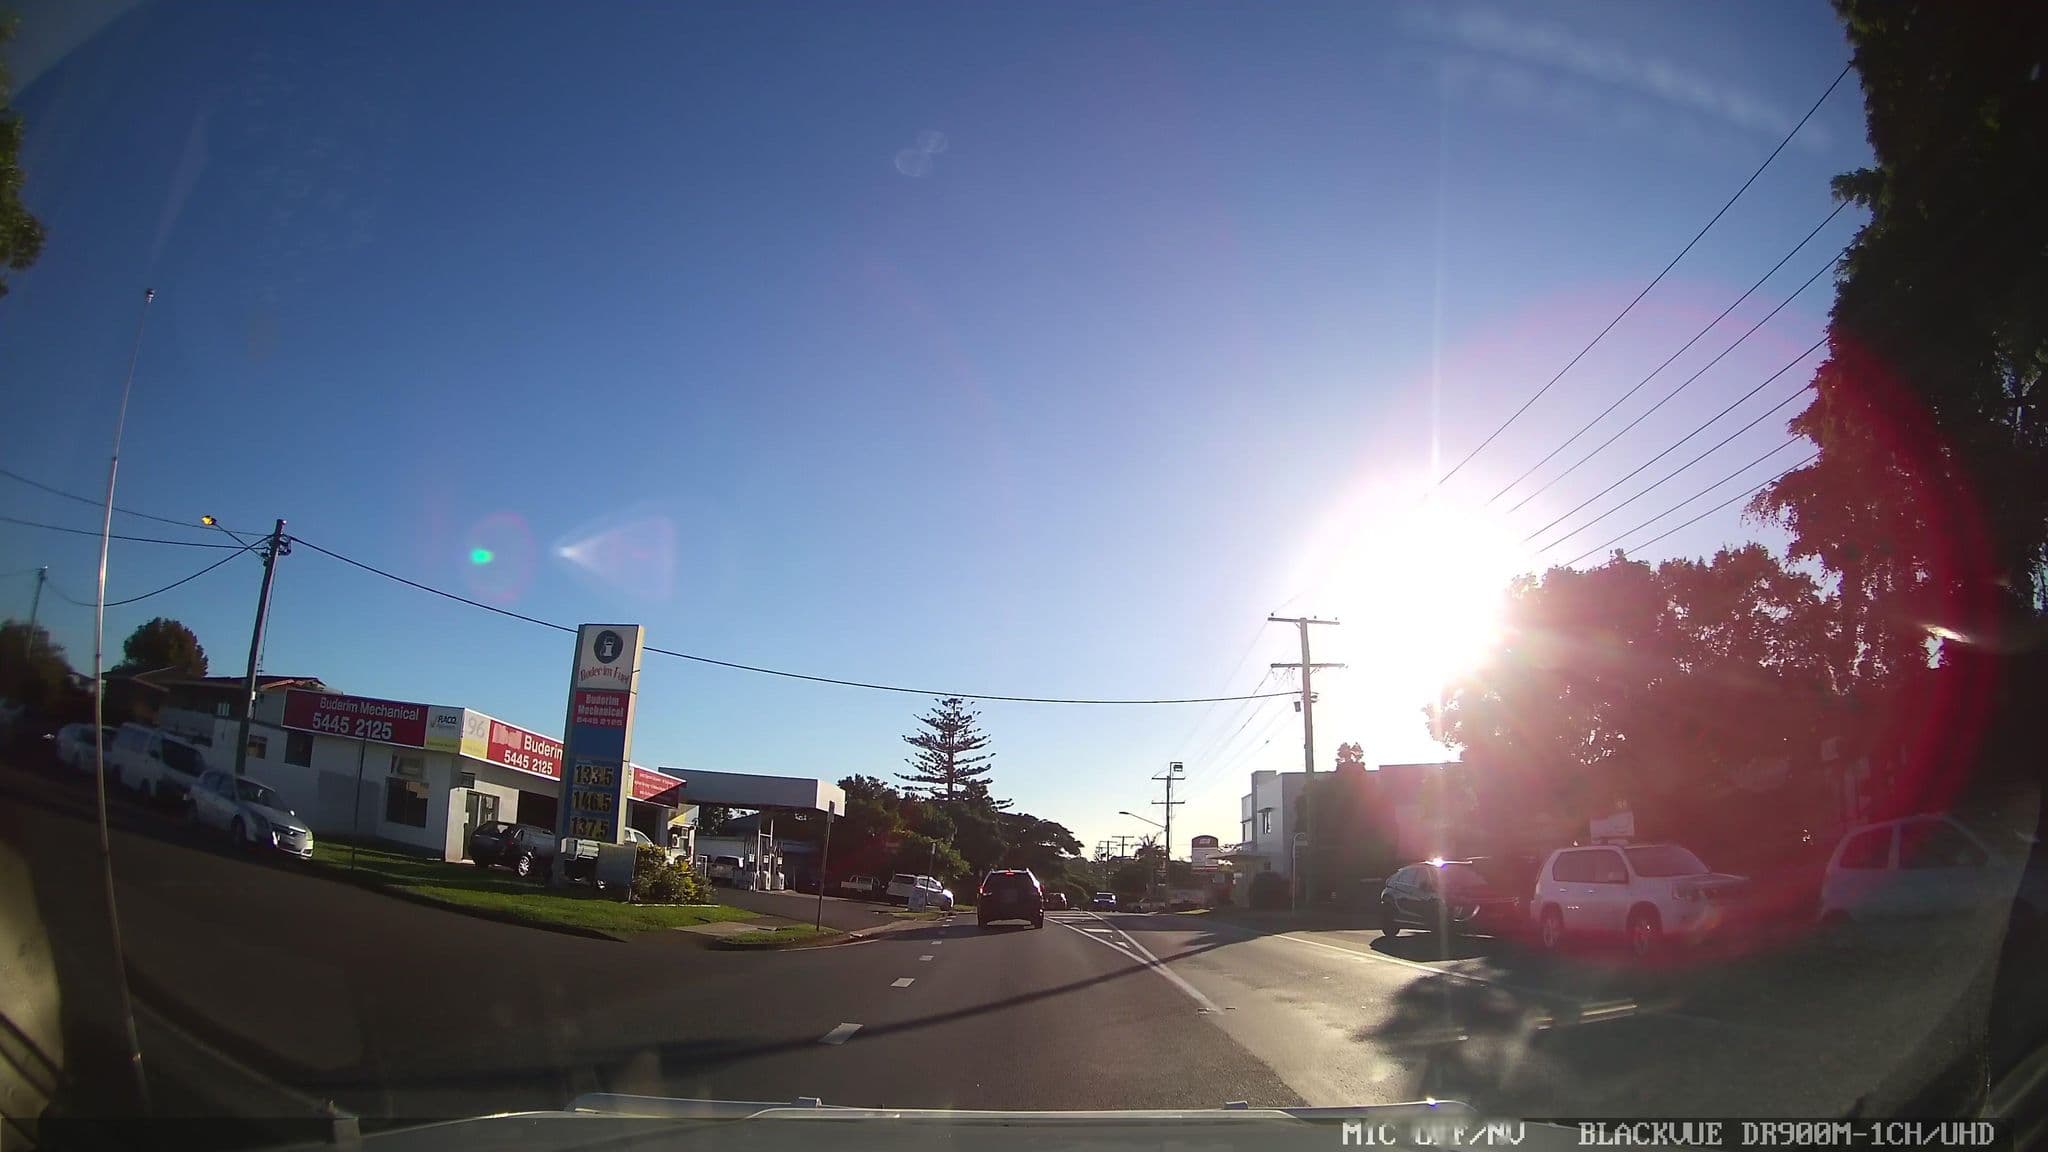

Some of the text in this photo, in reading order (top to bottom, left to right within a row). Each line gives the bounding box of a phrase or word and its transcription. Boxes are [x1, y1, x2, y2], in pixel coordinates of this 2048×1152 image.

[320, 697, 419, 720] Buderim Mechanical
[578, 705, 624, 718] Mechanical
[585, 694, 620, 706] Buderim
[312, 712, 393, 740] 5445 2125
[504, 750, 553, 775] 5445 2125
